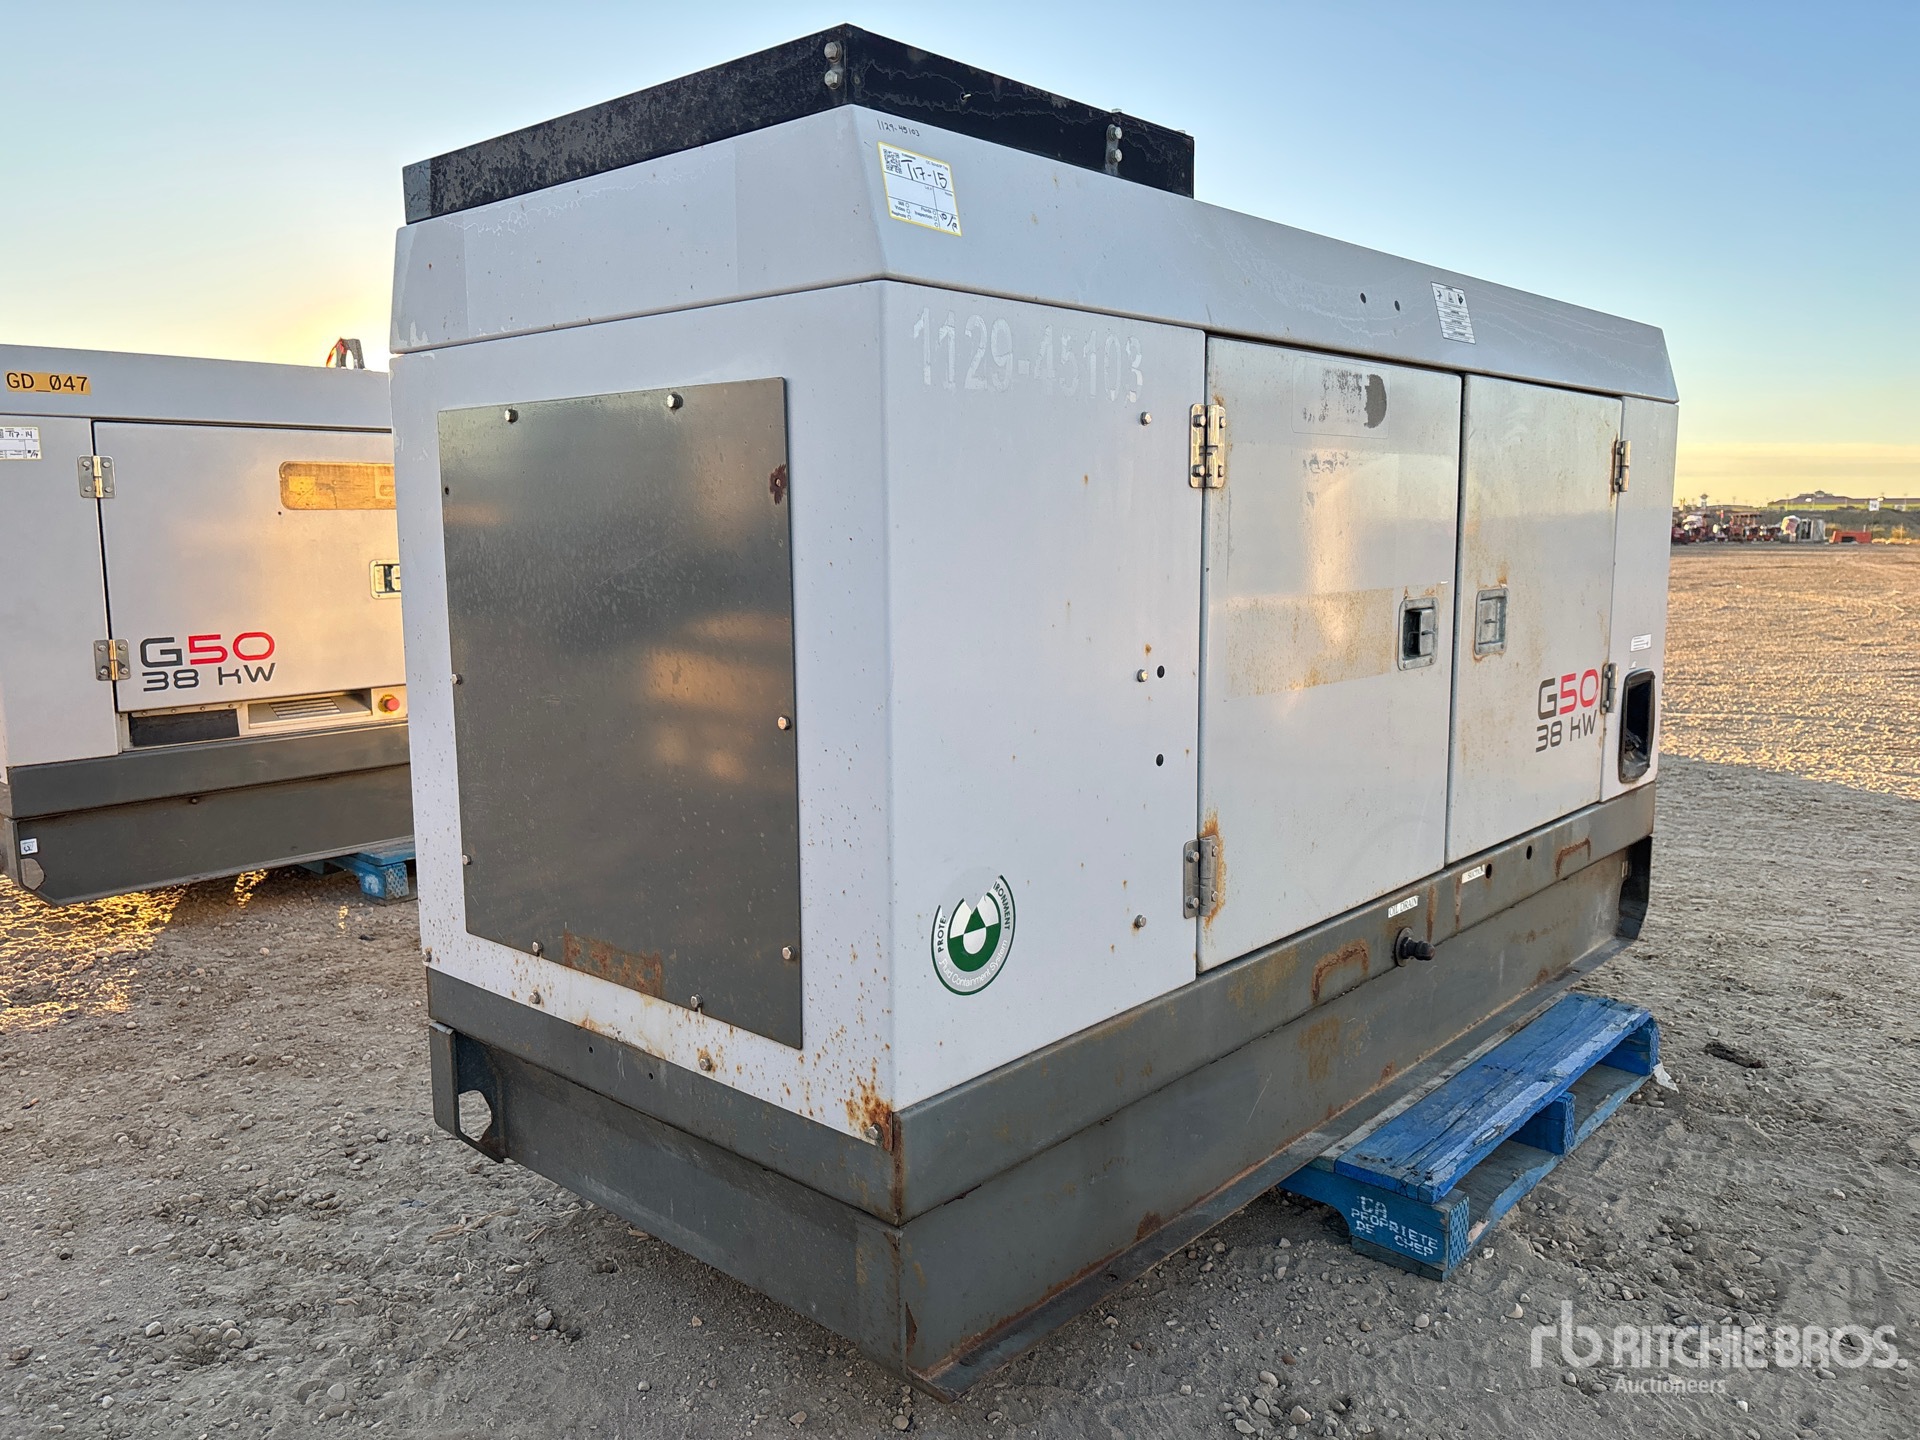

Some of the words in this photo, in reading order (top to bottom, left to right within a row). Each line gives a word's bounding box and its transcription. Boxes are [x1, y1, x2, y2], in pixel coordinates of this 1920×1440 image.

[877, 119, 920, 137] 1129-45103
[901, 159, 948, 189] T17-15
[913, 307, 1144, 403] 1129-45103
[6, 372, 88, 392] GD_047
[140, 632, 275, 668] G50
[142, 669, 199, 692] 38
[1538, 668, 1599, 720] G50
[1536, 720, 1562, 753] 38
[937, 914, 946, 953] PROTE
[1350, 1207, 1438, 1250] PROPRIETE
